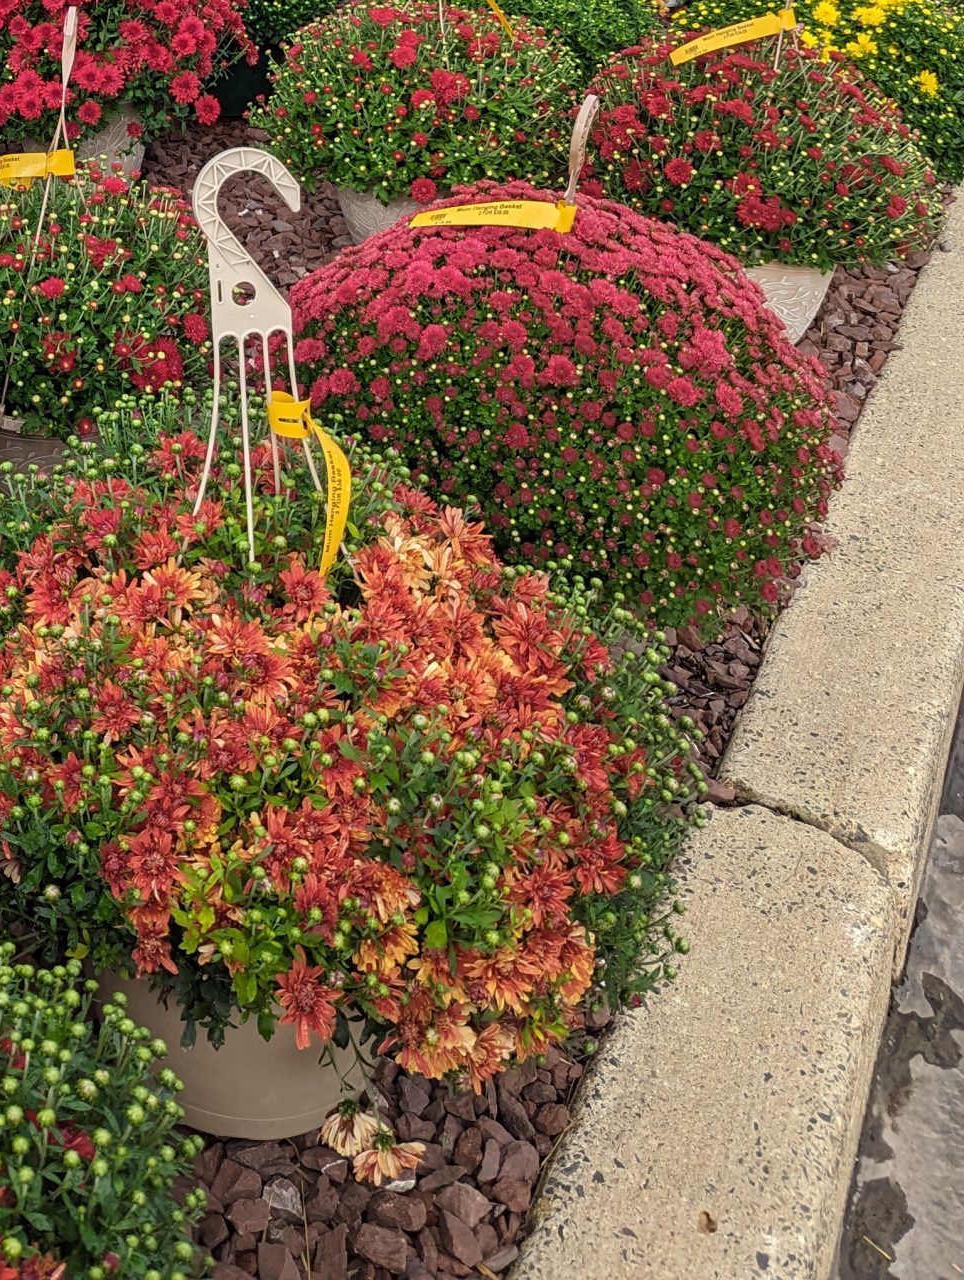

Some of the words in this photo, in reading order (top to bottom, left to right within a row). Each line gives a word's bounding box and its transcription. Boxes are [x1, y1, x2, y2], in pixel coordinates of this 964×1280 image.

[327, 450, 336, 483] Basket
[329, 486, 338, 527] Hanging
[325, 530, 333, 553] Mum
